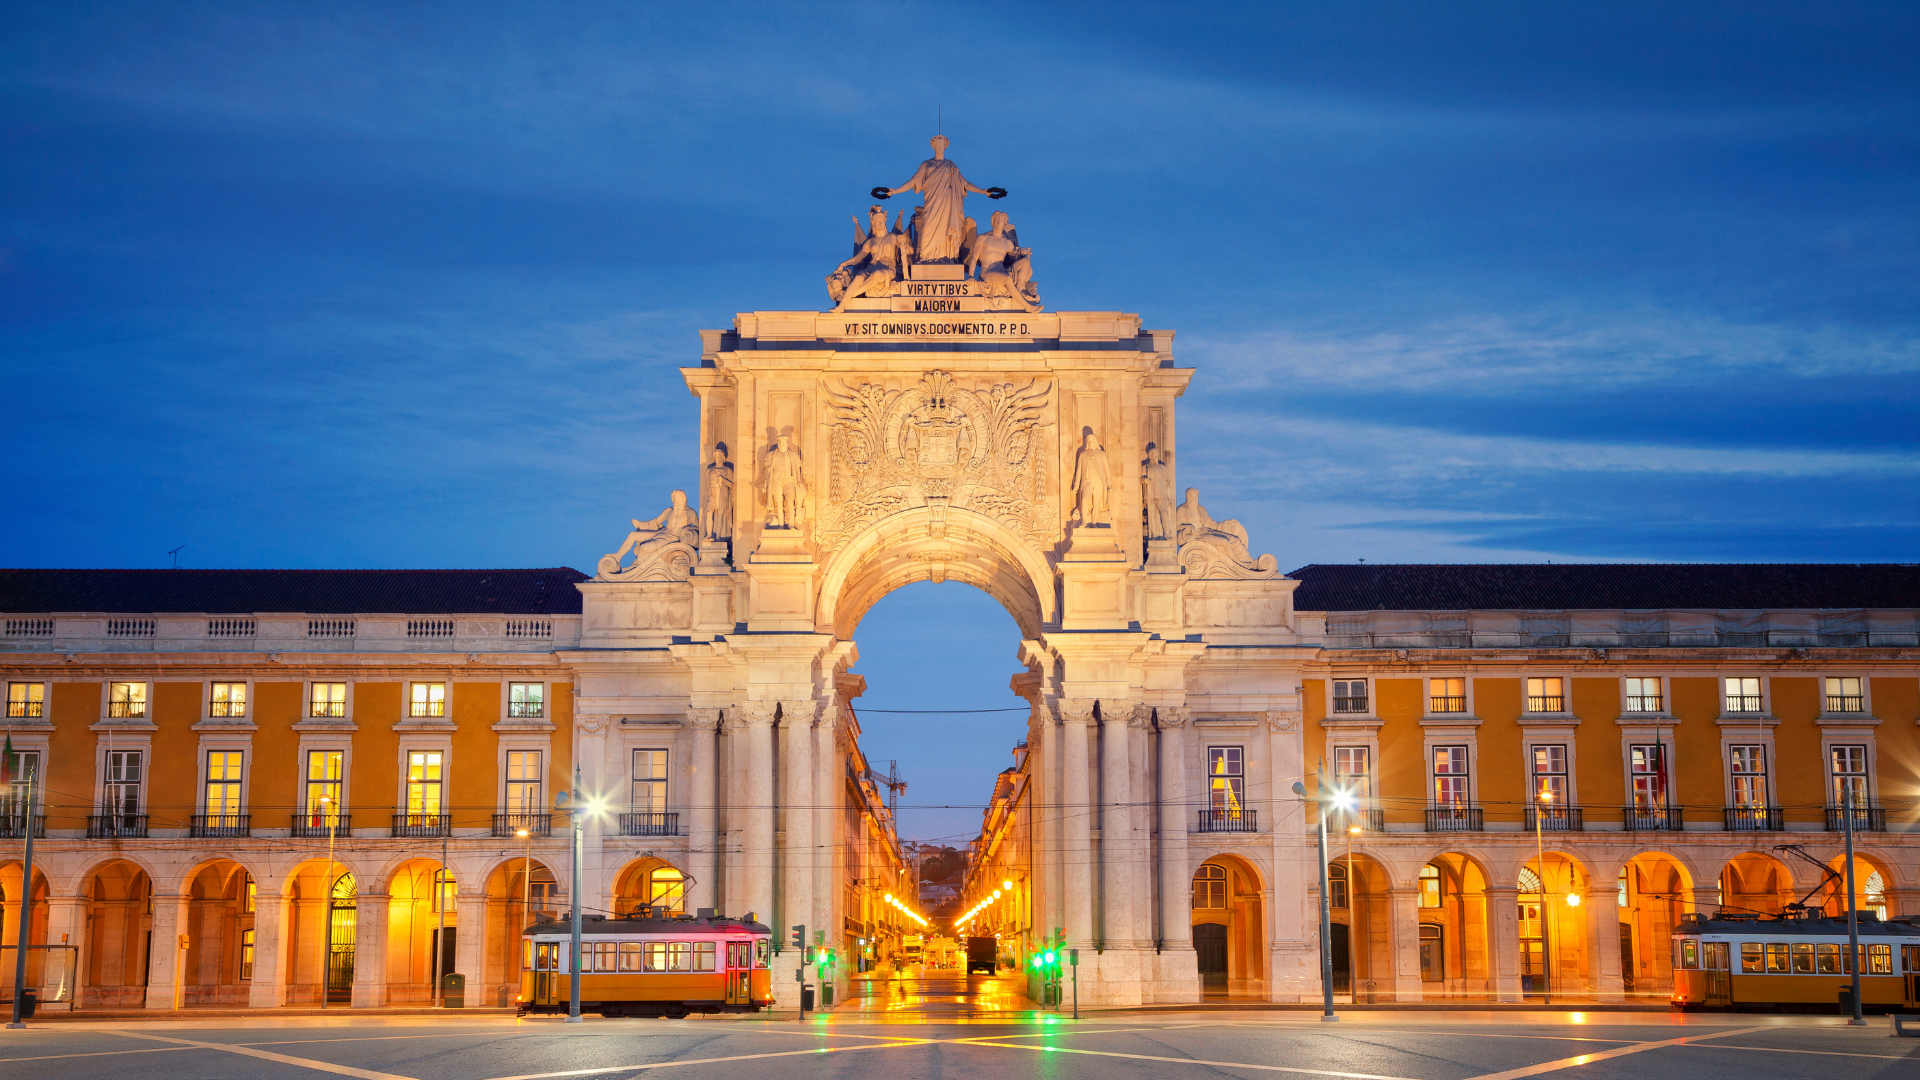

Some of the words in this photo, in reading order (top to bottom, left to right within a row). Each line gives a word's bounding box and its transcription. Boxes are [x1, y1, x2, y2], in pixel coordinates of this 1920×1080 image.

[907, 284, 968, 295] VIRTVTIBVS
[915, 300, 960, 312] MAIORVM
[862, 323, 879, 334] SIT.
